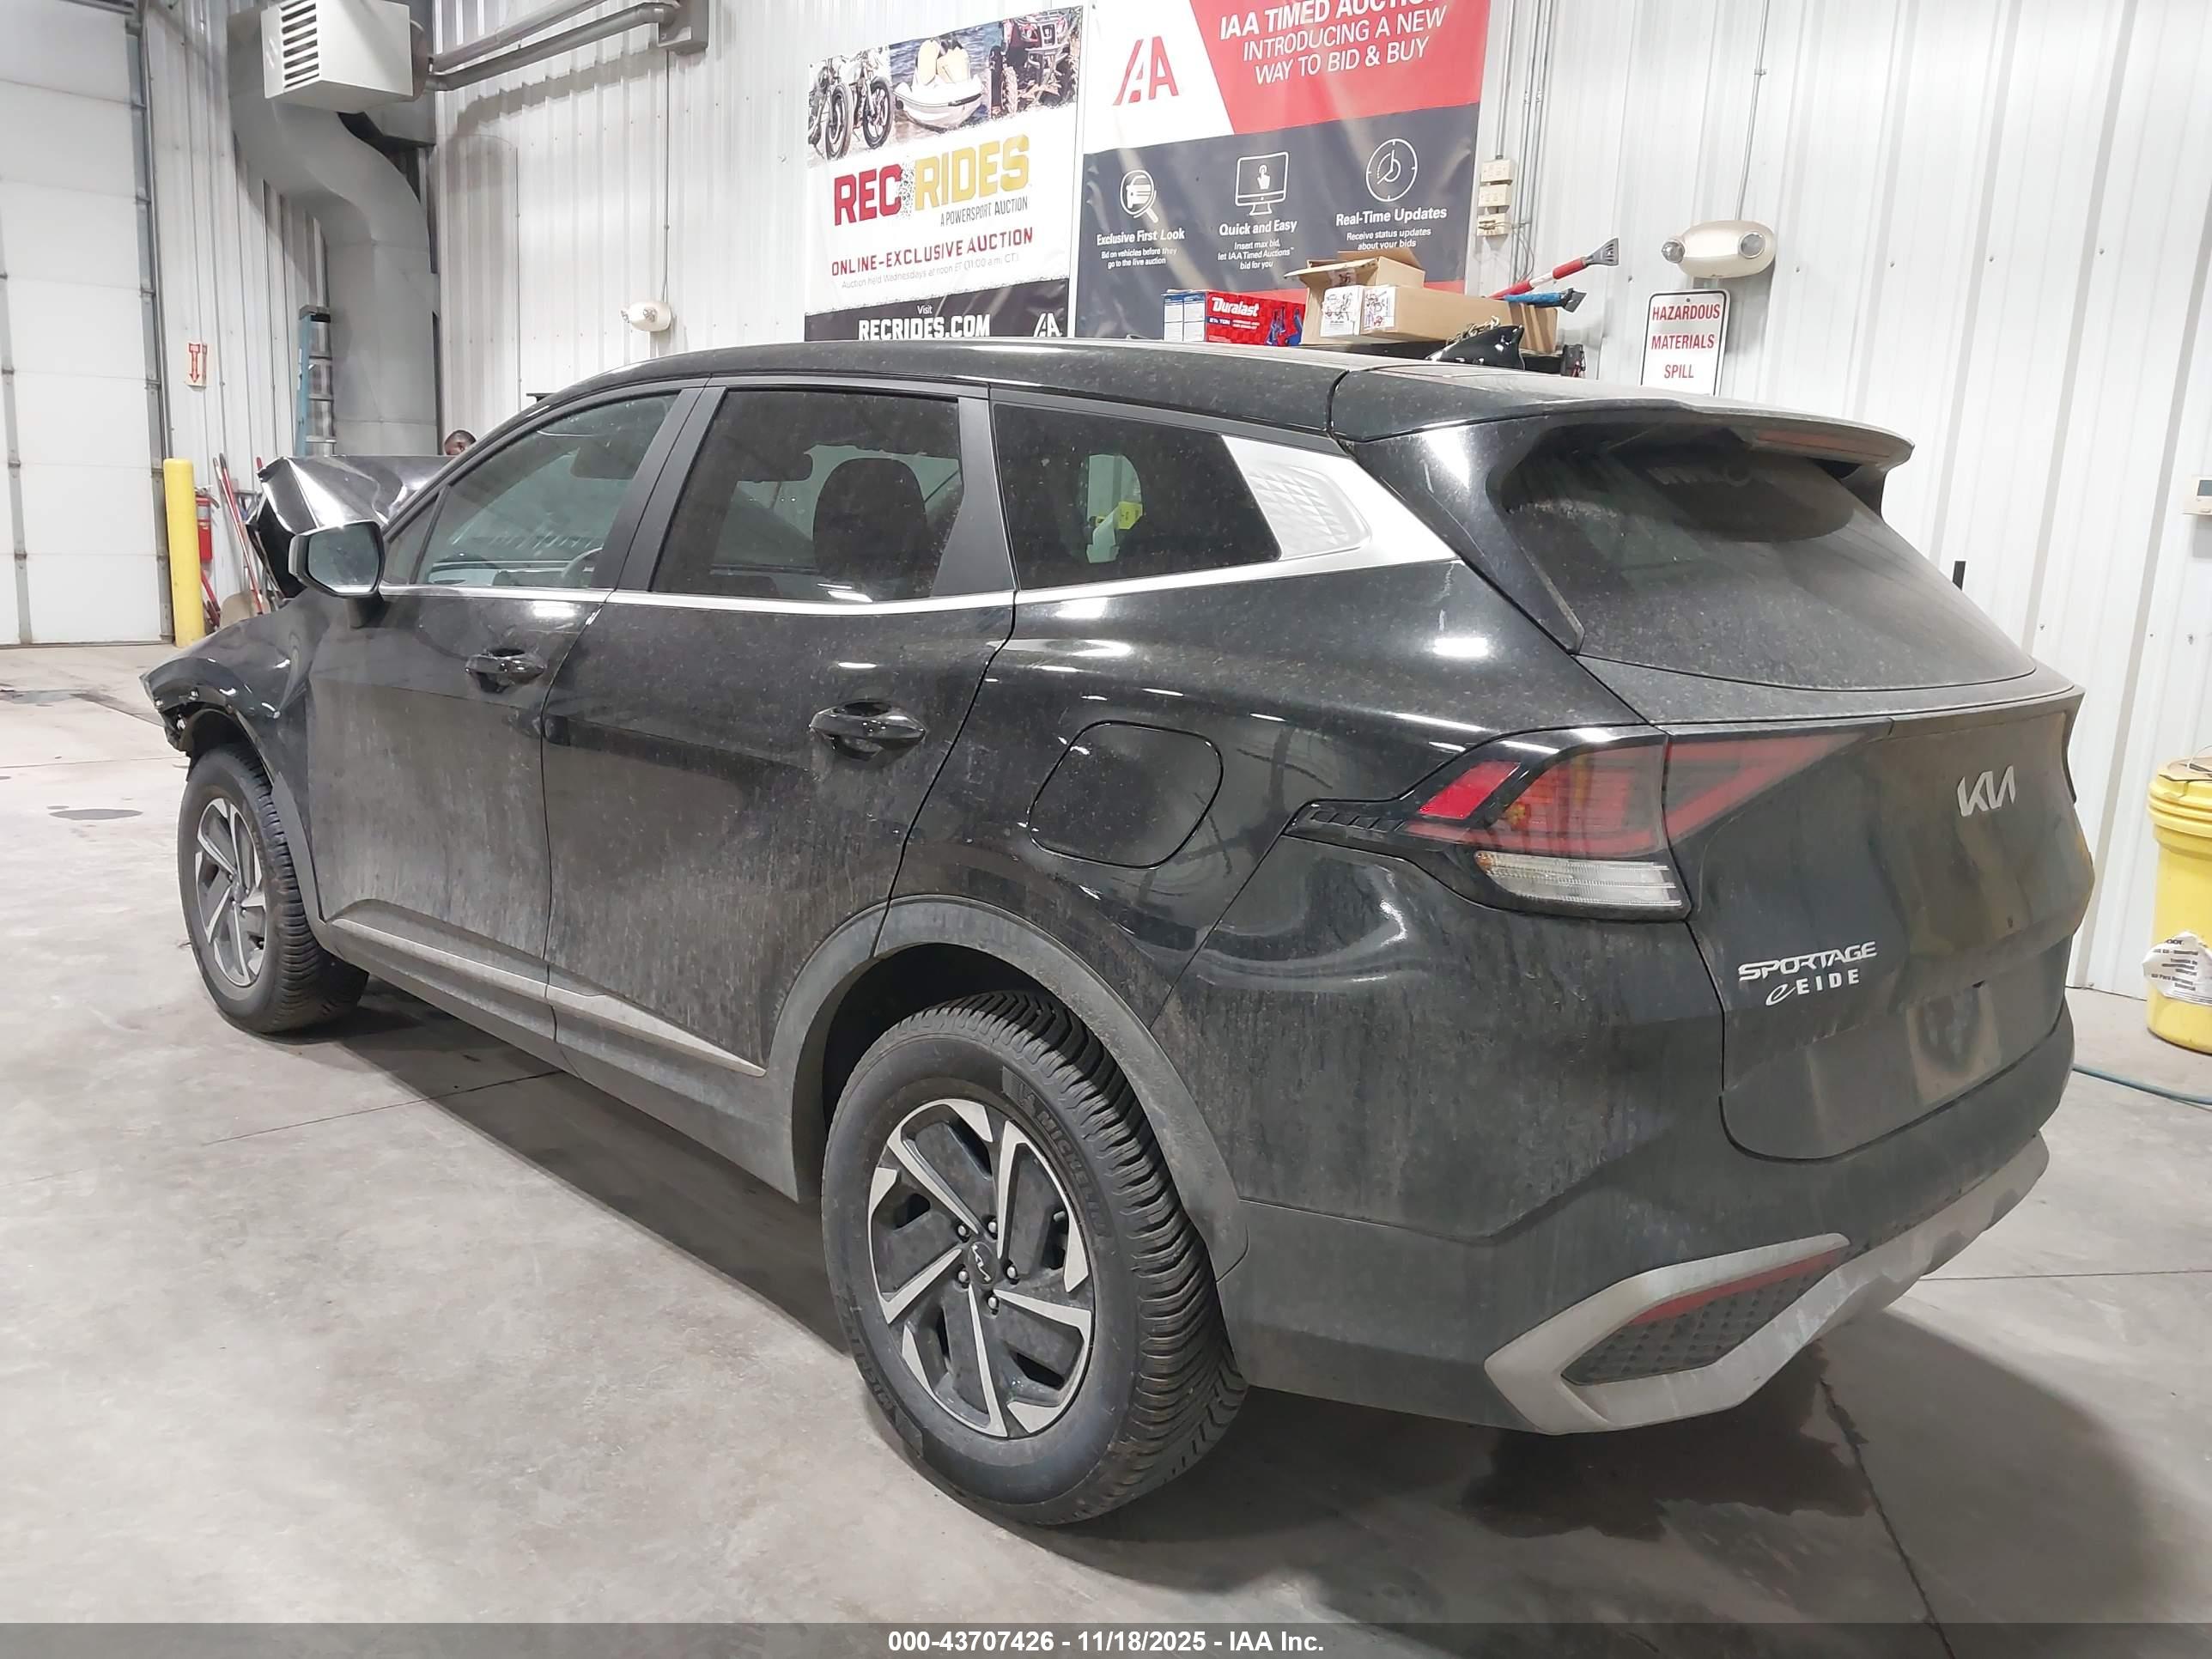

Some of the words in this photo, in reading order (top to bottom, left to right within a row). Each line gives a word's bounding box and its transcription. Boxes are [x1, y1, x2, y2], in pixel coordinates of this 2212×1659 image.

[1219, 11, 1260, 40] IAA
[1265, 0, 1330, 33] TIMED
[1243, 20, 1370, 62] INTRODUCING
[1375, 16, 1391, 39] A
[1396, 5, 1447, 34] NEW
[1255, 58, 1292, 85] WAY
[1297, 54, 1321, 76] TO
[1328, 48, 1360, 72] BID
[1364, 45, 1381, 67] &
[1387, 36, 1429, 64] BUY
[834, 164, 902, 226] REC
[915, 134, 1030, 211] RIDES
[940, 213, 945, 227] A
[945, 203, 992, 225] POWERSPORT
[994, 196, 1028, 216] AUCTION
[1336, 210, 1391, 226] Real-Time
[1395, 206, 1447, 223] Updates
[1219, 222, 1250, 235] Quick
[1252, 221, 1272, 234] and
[1273, 219, 1297, 233] Easy
[1346, 231, 1373, 240] Receive
[1375, 229, 1397, 239] status
[1399, 228, 1431, 238] updates
[1097, 232, 1135, 246] Exclusive
[1137, 229, 1158, 241] First
[1160, 228, 1185, 240] Look
[1234, 241, 1253, 250] Insert
[1380, 240, 1397, 249] your
[831, 240, 963, 276] ONLINE-EXCLUSIVE
[967, 227, 1033, 253] AUCTION
[1118, 249, 1141, 258] vehicles
[1228, 252, 1242, 260] IAA
[1243, 251, 1262, 259] Timed
[917, 305, 933, 314] Visit
[1212, 296, 1260, 317] Duralast
[1652, 304, 1720, 320] HAZARDOUS
[859, 314, 990, 340] RECRIDES.COM
[1651, 334, 1715, 349] MATERIALS
[1664, 364, 1694, 379] SPILL
[1738, 941, 1877, 981] SPORTAGE
